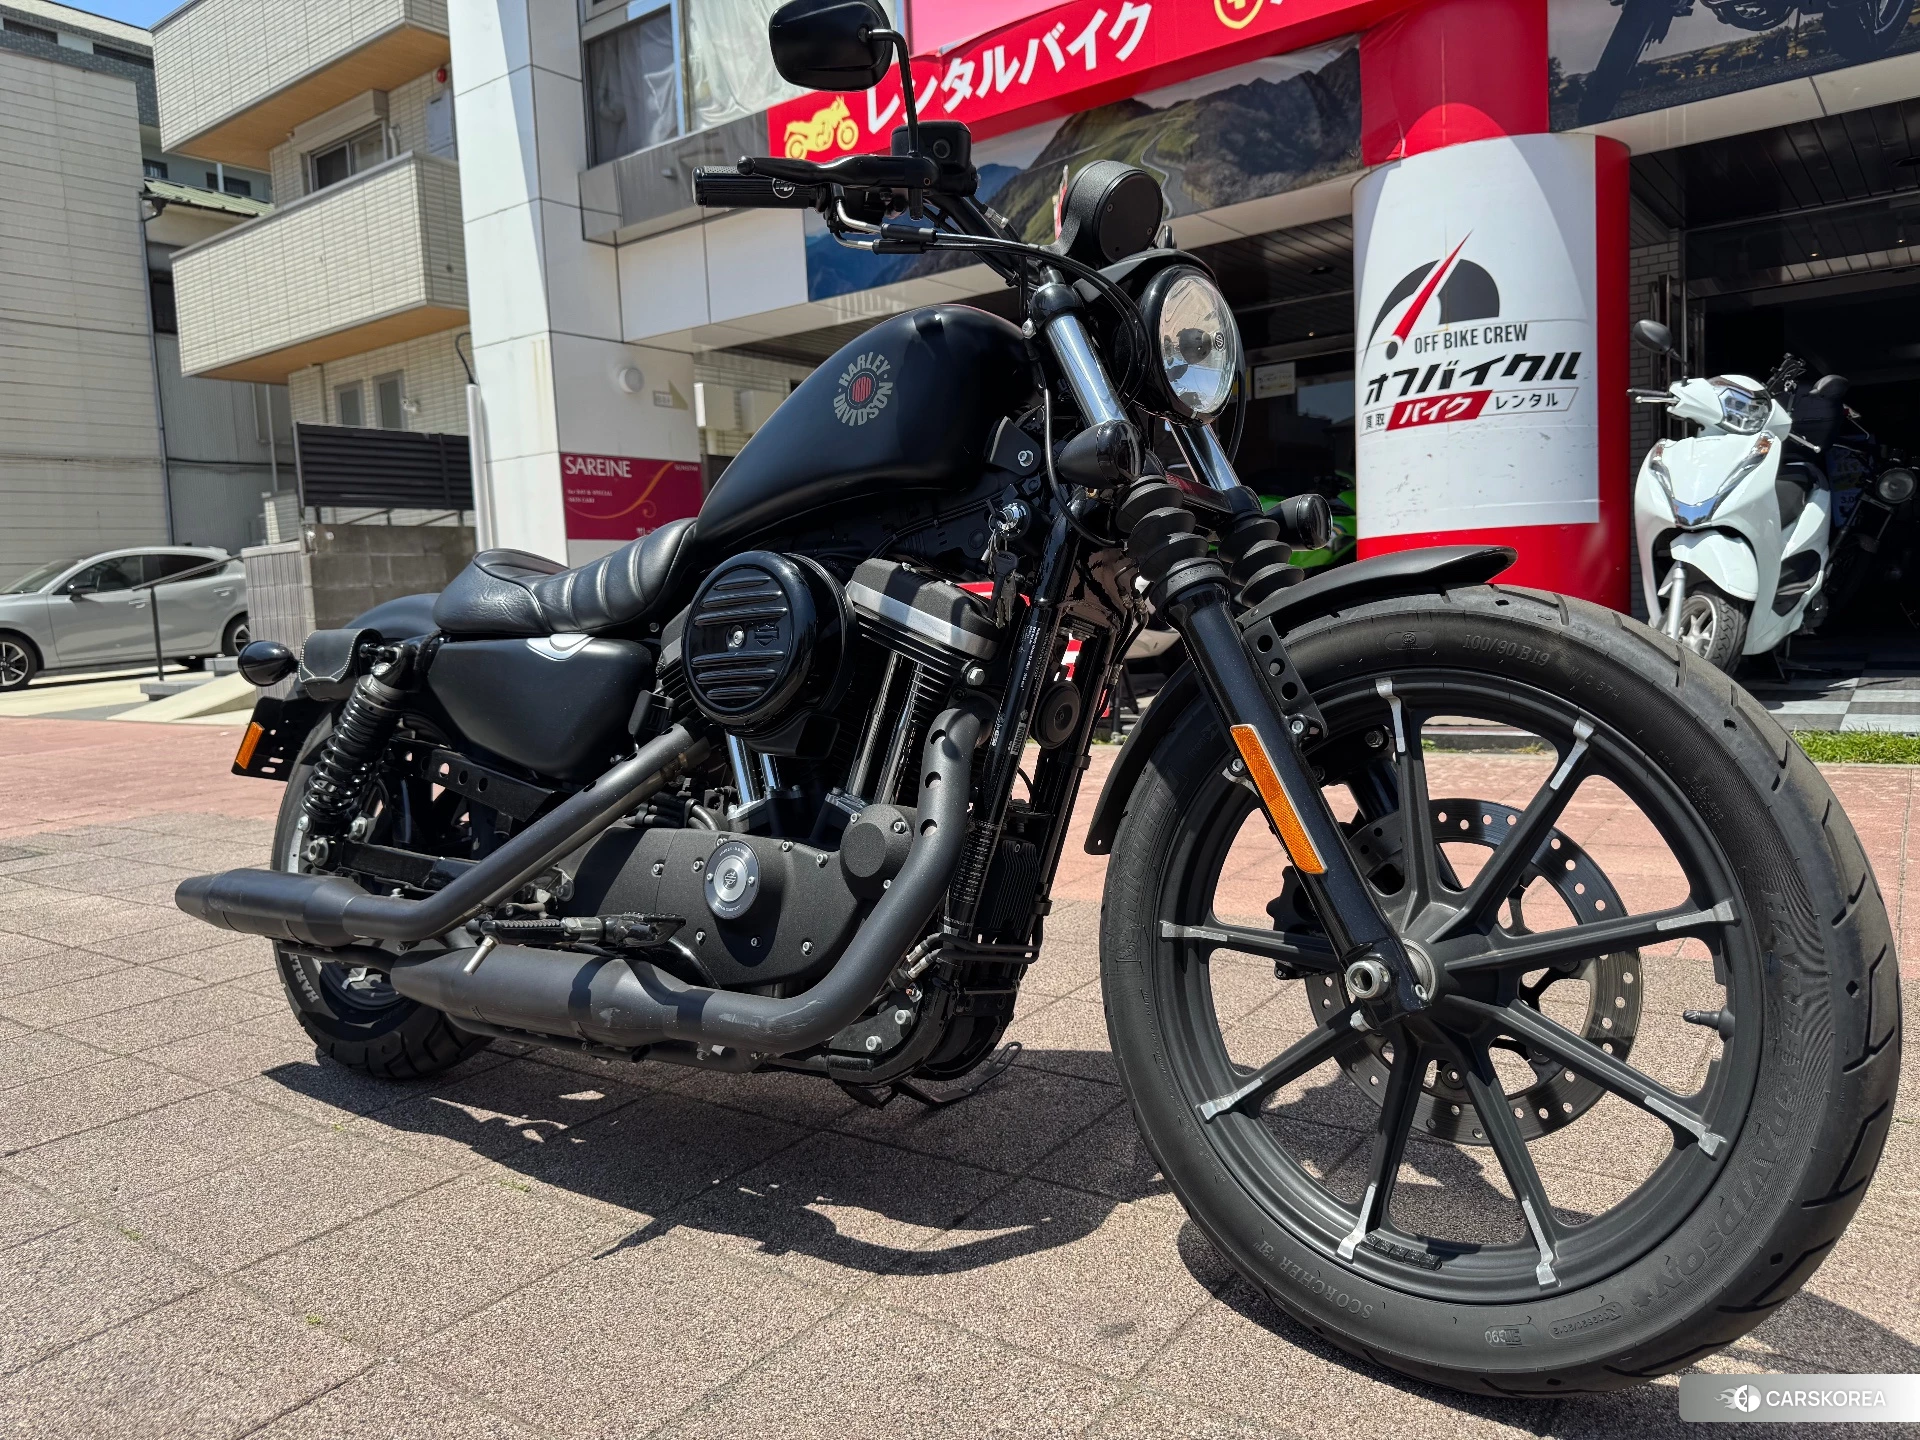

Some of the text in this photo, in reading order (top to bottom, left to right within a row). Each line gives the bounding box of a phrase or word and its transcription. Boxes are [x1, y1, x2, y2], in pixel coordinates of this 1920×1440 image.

[866, 2, 1152, 134] レンタルバイク
[1414, 323, 1528, 354] OFF BIKE CREW
[838, 351, 891, 387] HARLEY
[1364, 352, 1582, 406] オフバイクル
[833, 381, 894, 427] DAVIDSON
[1399, 396, 1473, 425] バイク
[1495, 393, 1559, 410] レンタル
[565, 456, 632, 478] SAREINE
[1462, 633, 1550, 667] 100/90 B19
[1278, 1256, 1373, 1319] SCORCHER
